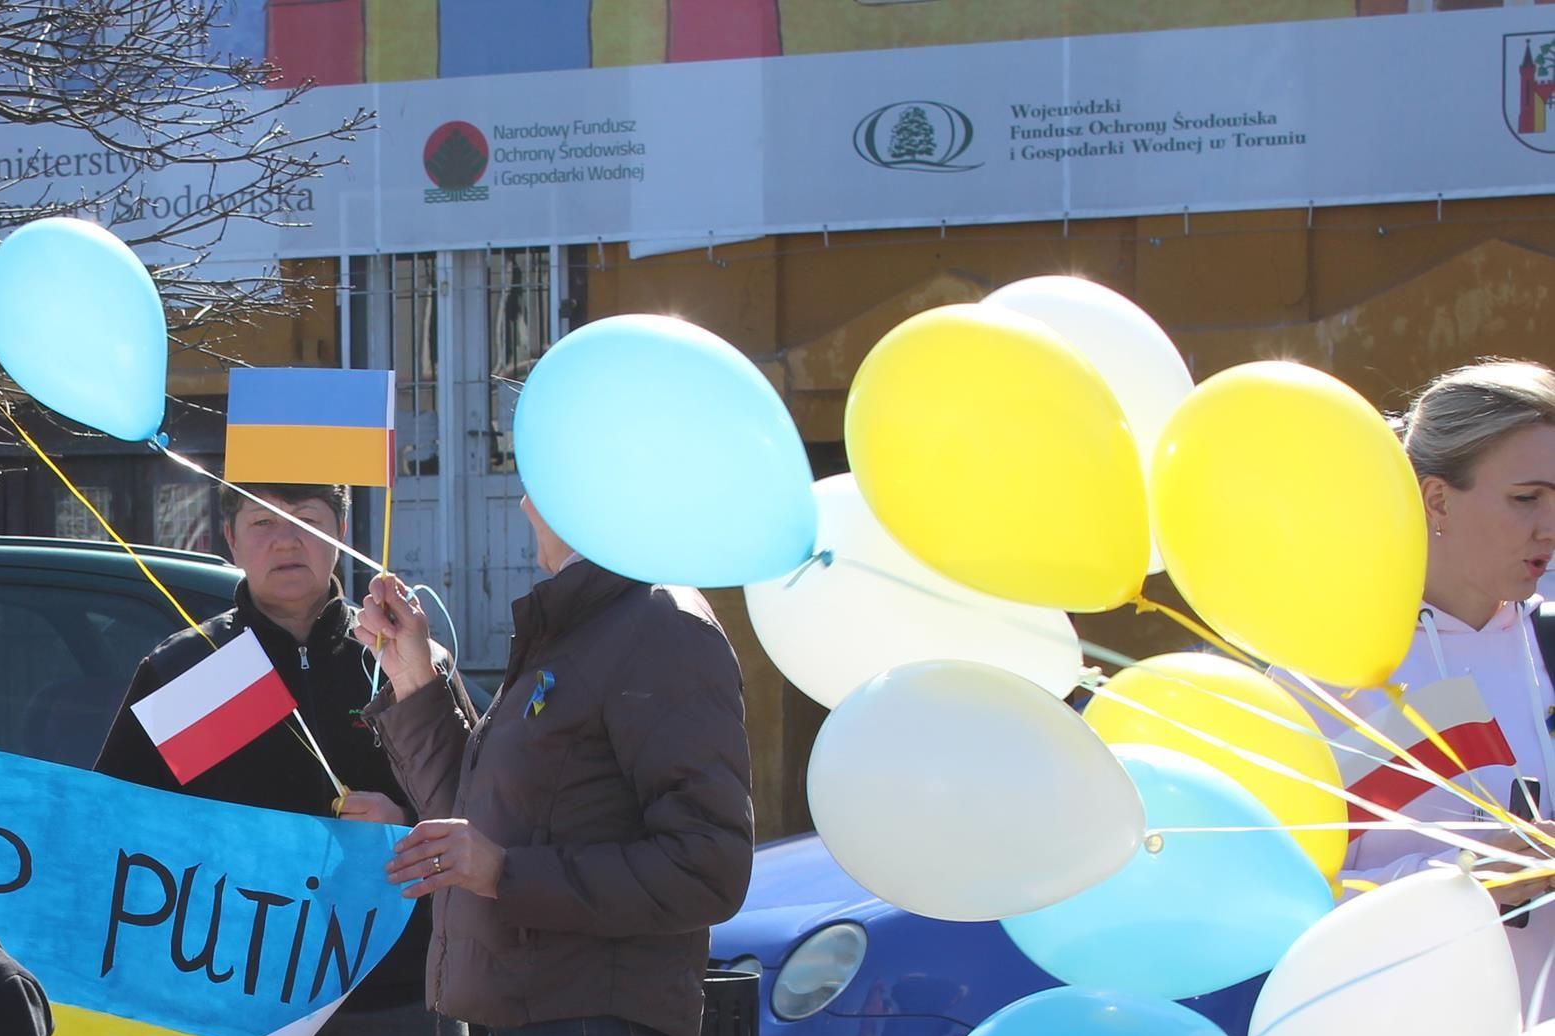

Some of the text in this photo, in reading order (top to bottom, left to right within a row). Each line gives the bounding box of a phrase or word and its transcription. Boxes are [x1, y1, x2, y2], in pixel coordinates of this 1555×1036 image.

[1010, 99, 1122, 122] Wojewódzki
[494, 118, 637, 139] Narodowy Fundusz
[1009, 110, 1277, 140] Fundusz Ochrony Środowiska
[494, 139, 646, 164] Ochrony Środowiska
[1009, 131, 1306, 163] i Gospodarki Wodnej w Toruniu
[494, 163, 645, 188] i Gospodarki Wodnej
